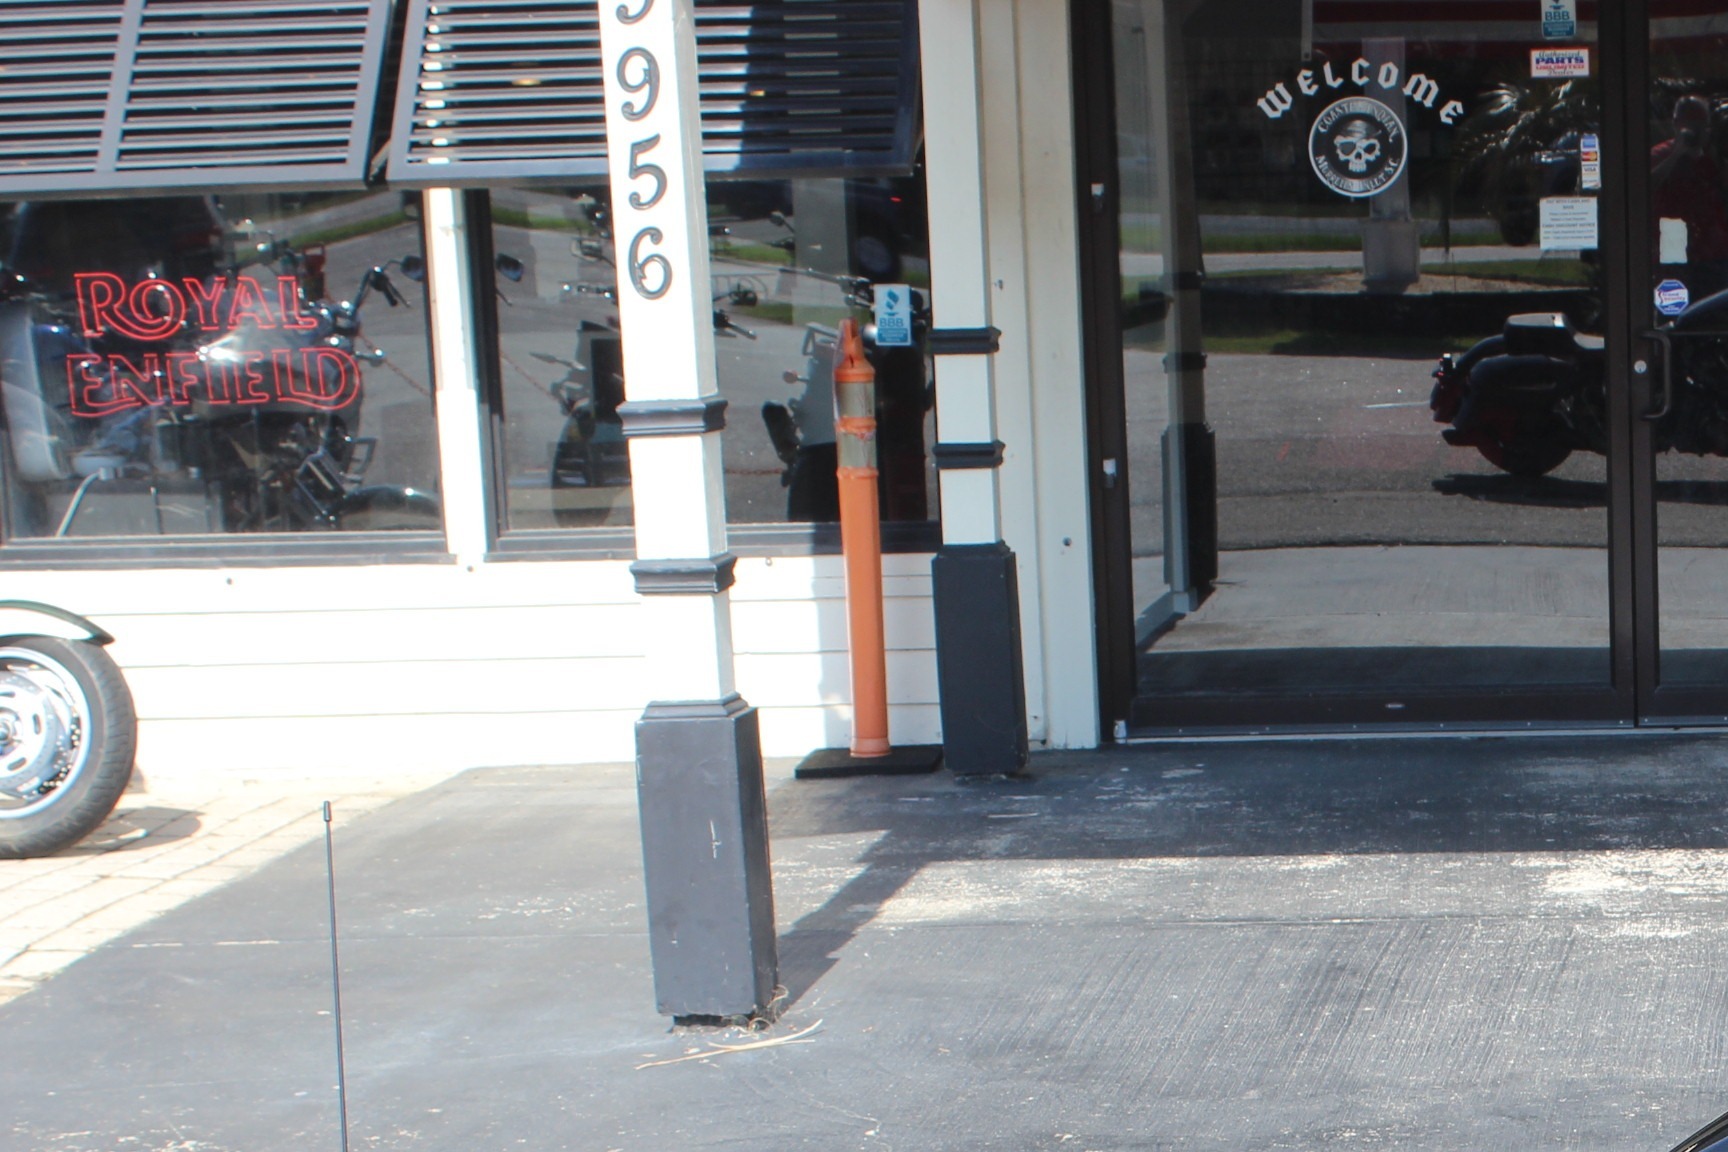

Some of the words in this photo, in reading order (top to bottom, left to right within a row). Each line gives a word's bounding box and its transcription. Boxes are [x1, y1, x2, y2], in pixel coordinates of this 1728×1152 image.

[1545, 11, 1570, 20] BBB
[1536, 56, 1585, 65] PARTS
[73, 272, 318, 341] ROYAL
[879, 317, 904, 328] BBB
[66, 347, 361, 418] ENFIELD
